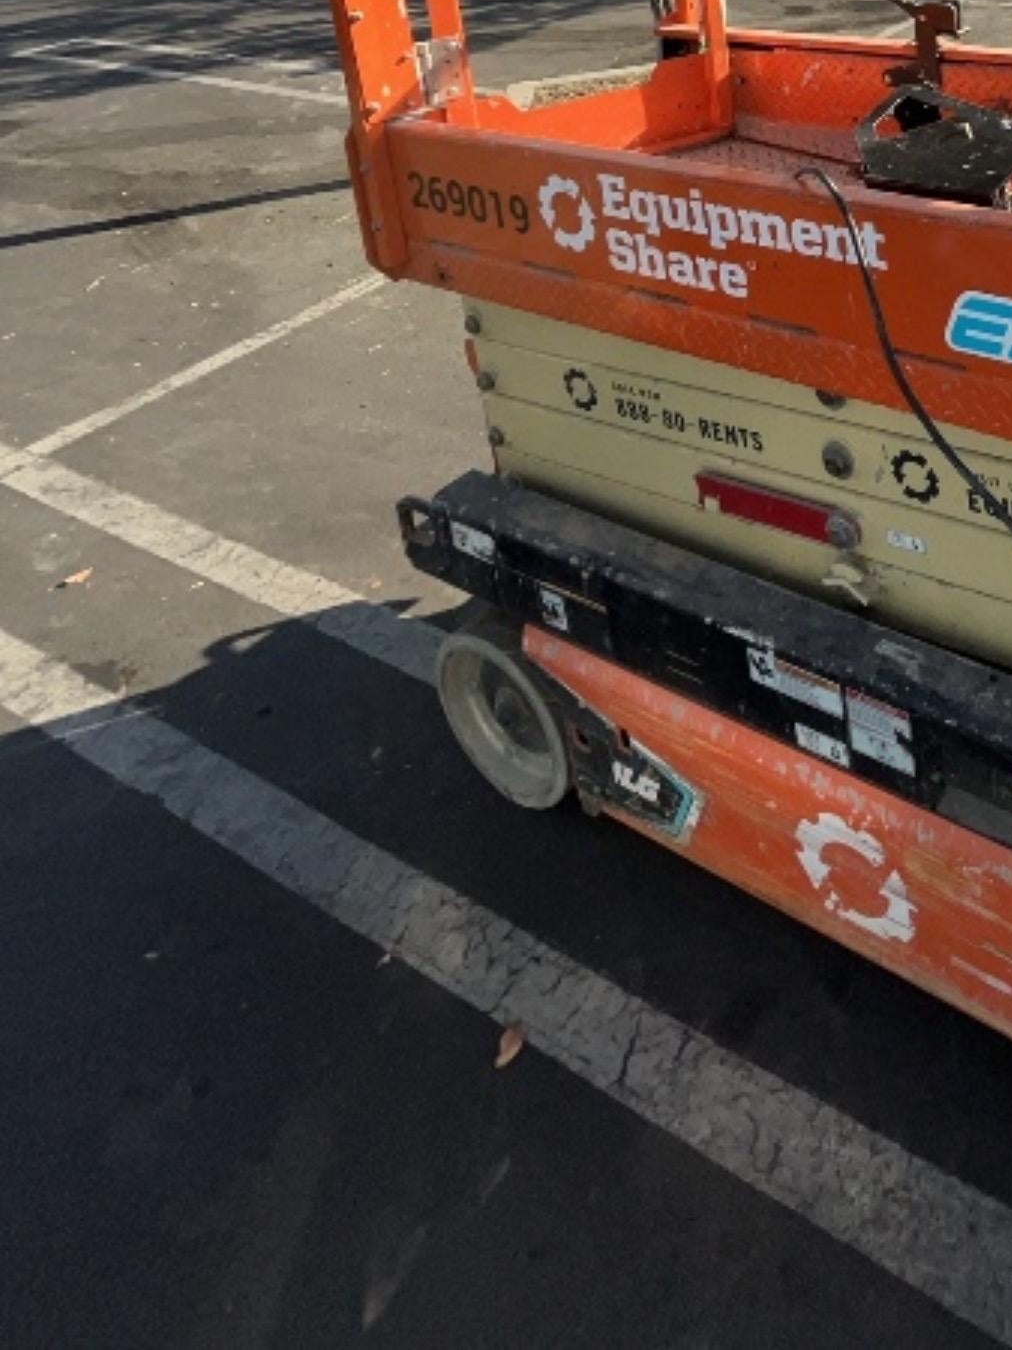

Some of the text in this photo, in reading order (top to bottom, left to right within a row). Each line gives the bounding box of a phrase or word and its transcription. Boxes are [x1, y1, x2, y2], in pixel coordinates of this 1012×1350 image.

[407, 171, 530, 235] 269019
[596, 173, 889, 271] Equipment
[604, 228, 749, 298] Share
